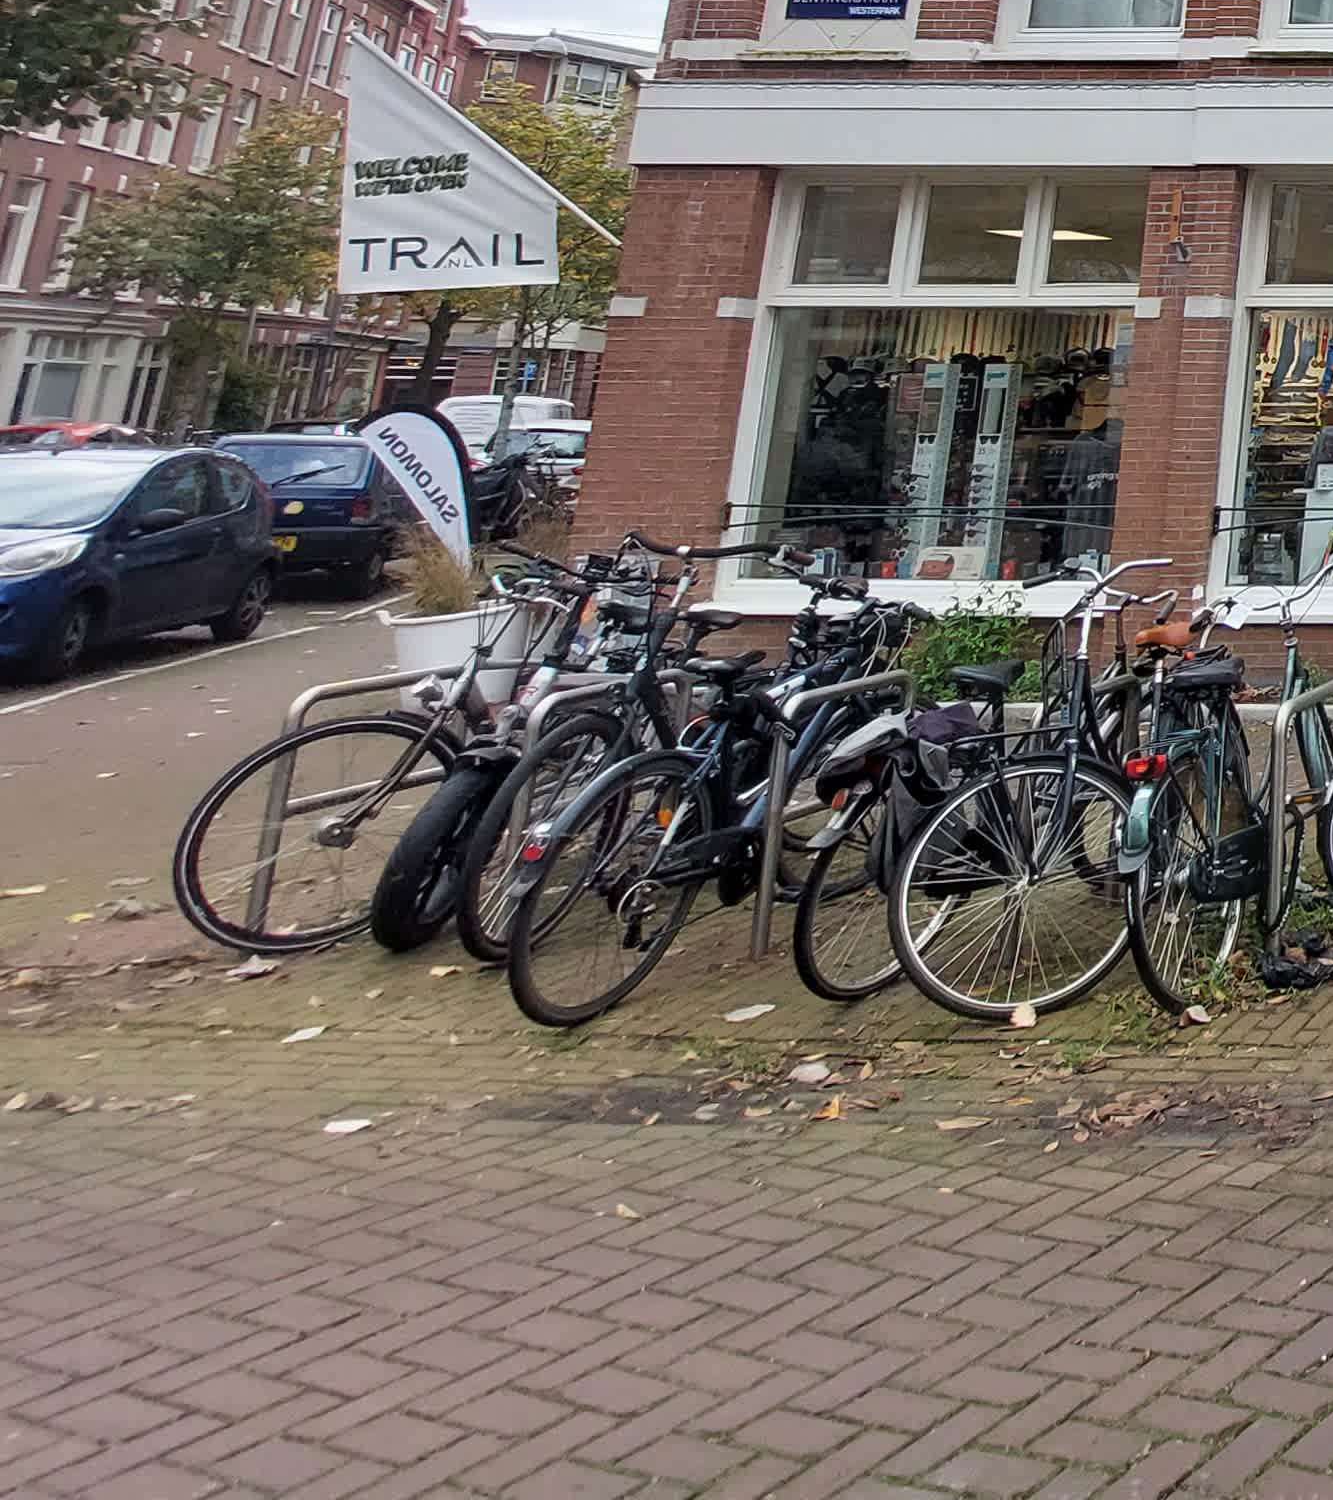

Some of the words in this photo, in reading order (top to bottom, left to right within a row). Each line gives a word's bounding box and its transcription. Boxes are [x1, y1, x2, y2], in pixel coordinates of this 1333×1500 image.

[355, 152, 470, 180] WELCOME
[414, 173, 468, 192] OPEN
[348, 233, 545, 272] TRAIL
